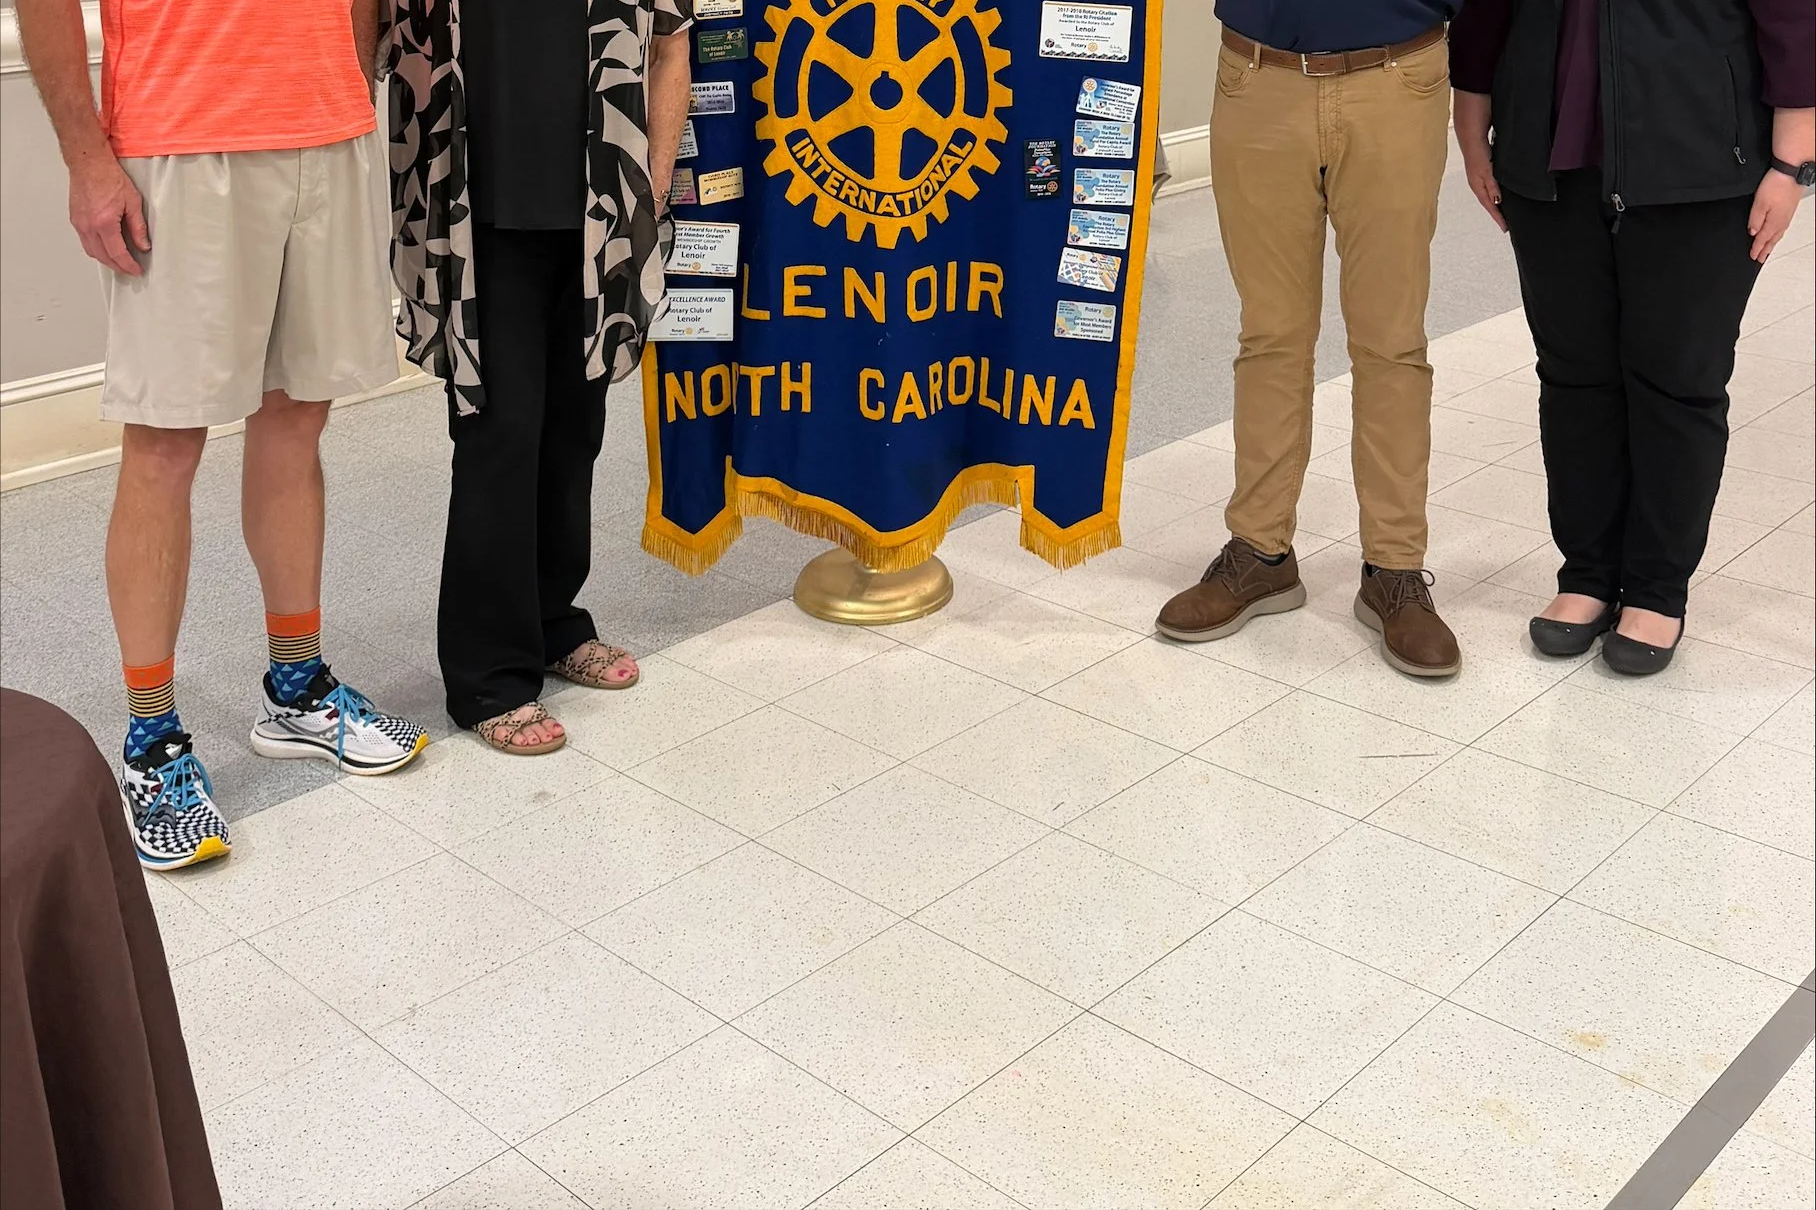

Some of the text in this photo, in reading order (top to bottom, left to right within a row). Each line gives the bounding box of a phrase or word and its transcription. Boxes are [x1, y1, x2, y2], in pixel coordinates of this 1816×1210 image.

[791, 138, 973, 216] INTERNATIONAL
[681, 251, 706, 259] Lenoir
[741, 261, 1004, 323] LENOIR
[1085, 306, 1101, 314] Rotary
[858, 356, 1095, 429] CAROLINA
